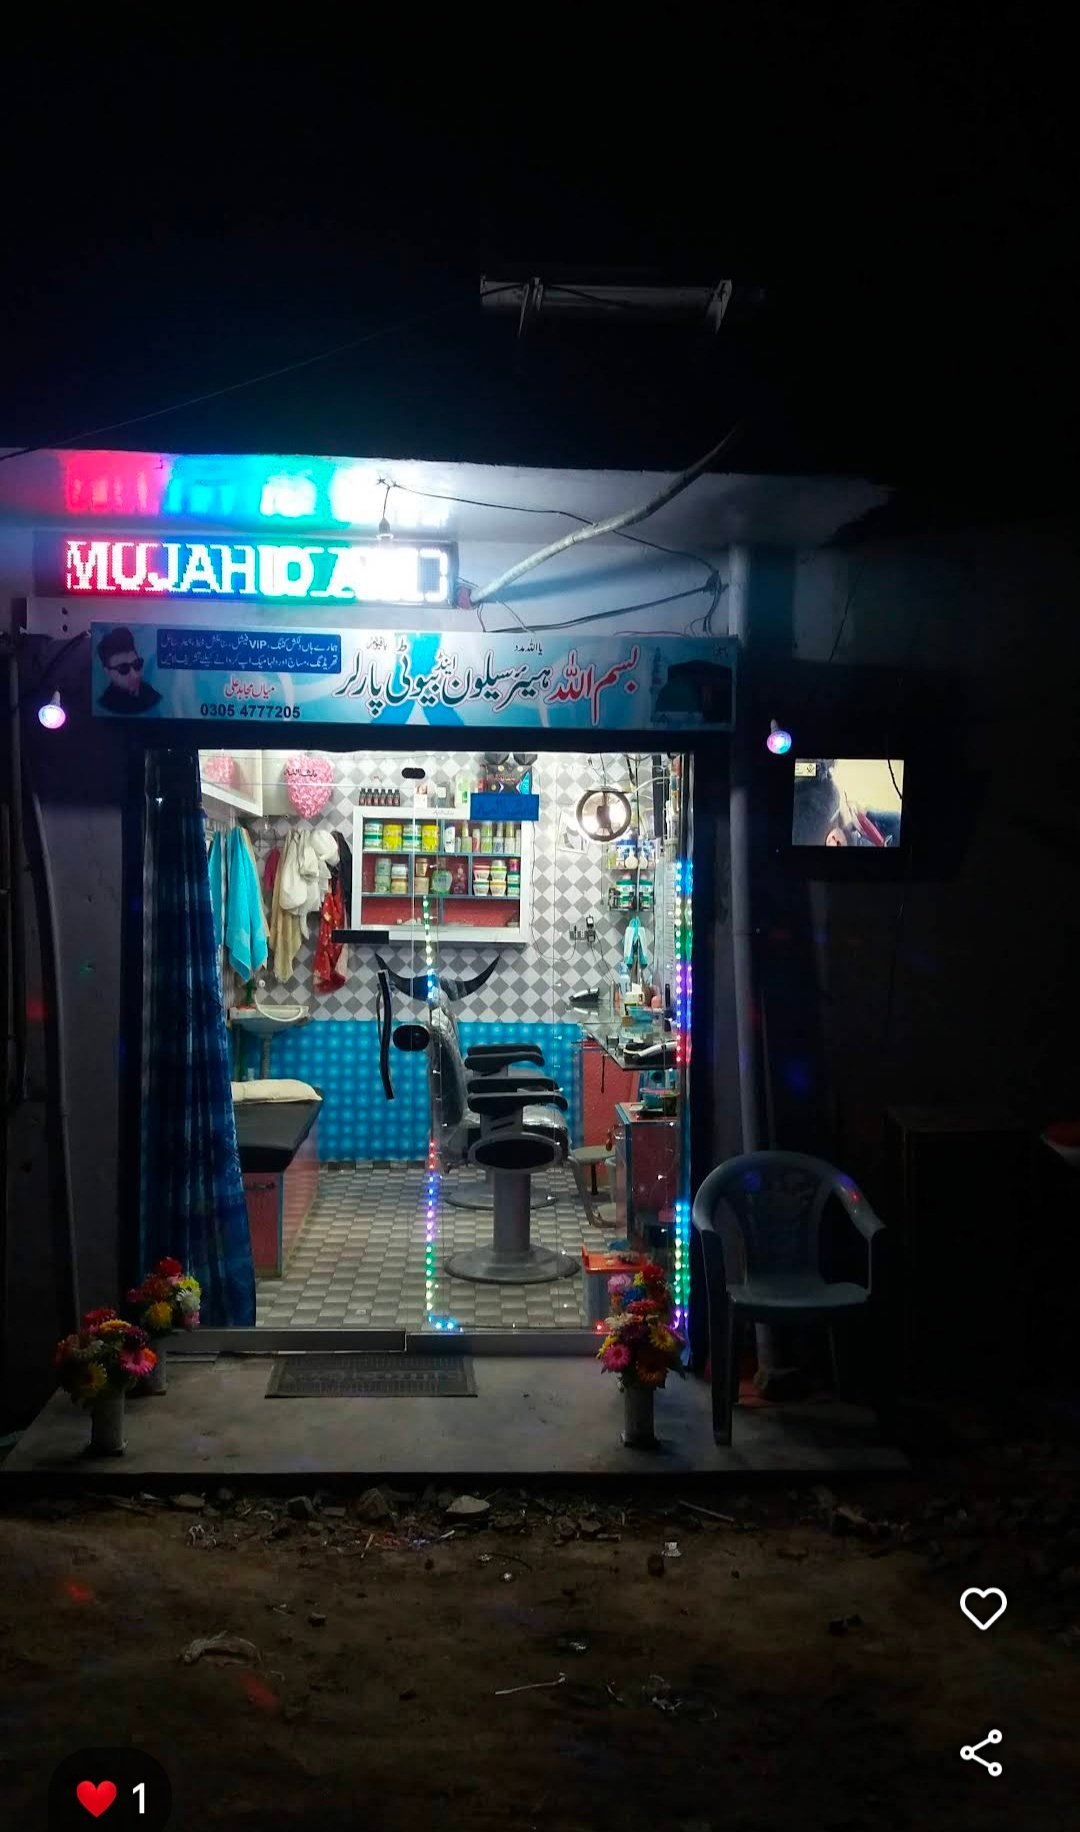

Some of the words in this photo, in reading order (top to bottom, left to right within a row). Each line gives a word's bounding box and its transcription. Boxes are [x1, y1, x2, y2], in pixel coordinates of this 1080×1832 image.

[67, 540, 312, 598] MUJAHID
[249, 640, 267, 650] VIP
[334, 652, 381, 716] پارلر
[549, 652, 592, 701] اللہ
[592, 645, 638, 727] بسم
[224, 677, 239, 697] علی
[236, 682, 254, 700] مجاہد
[252, 682, 275, 699] میاں
[201, 703, 235, 717] 0305
[240, 704, 301, 719] 4777205
